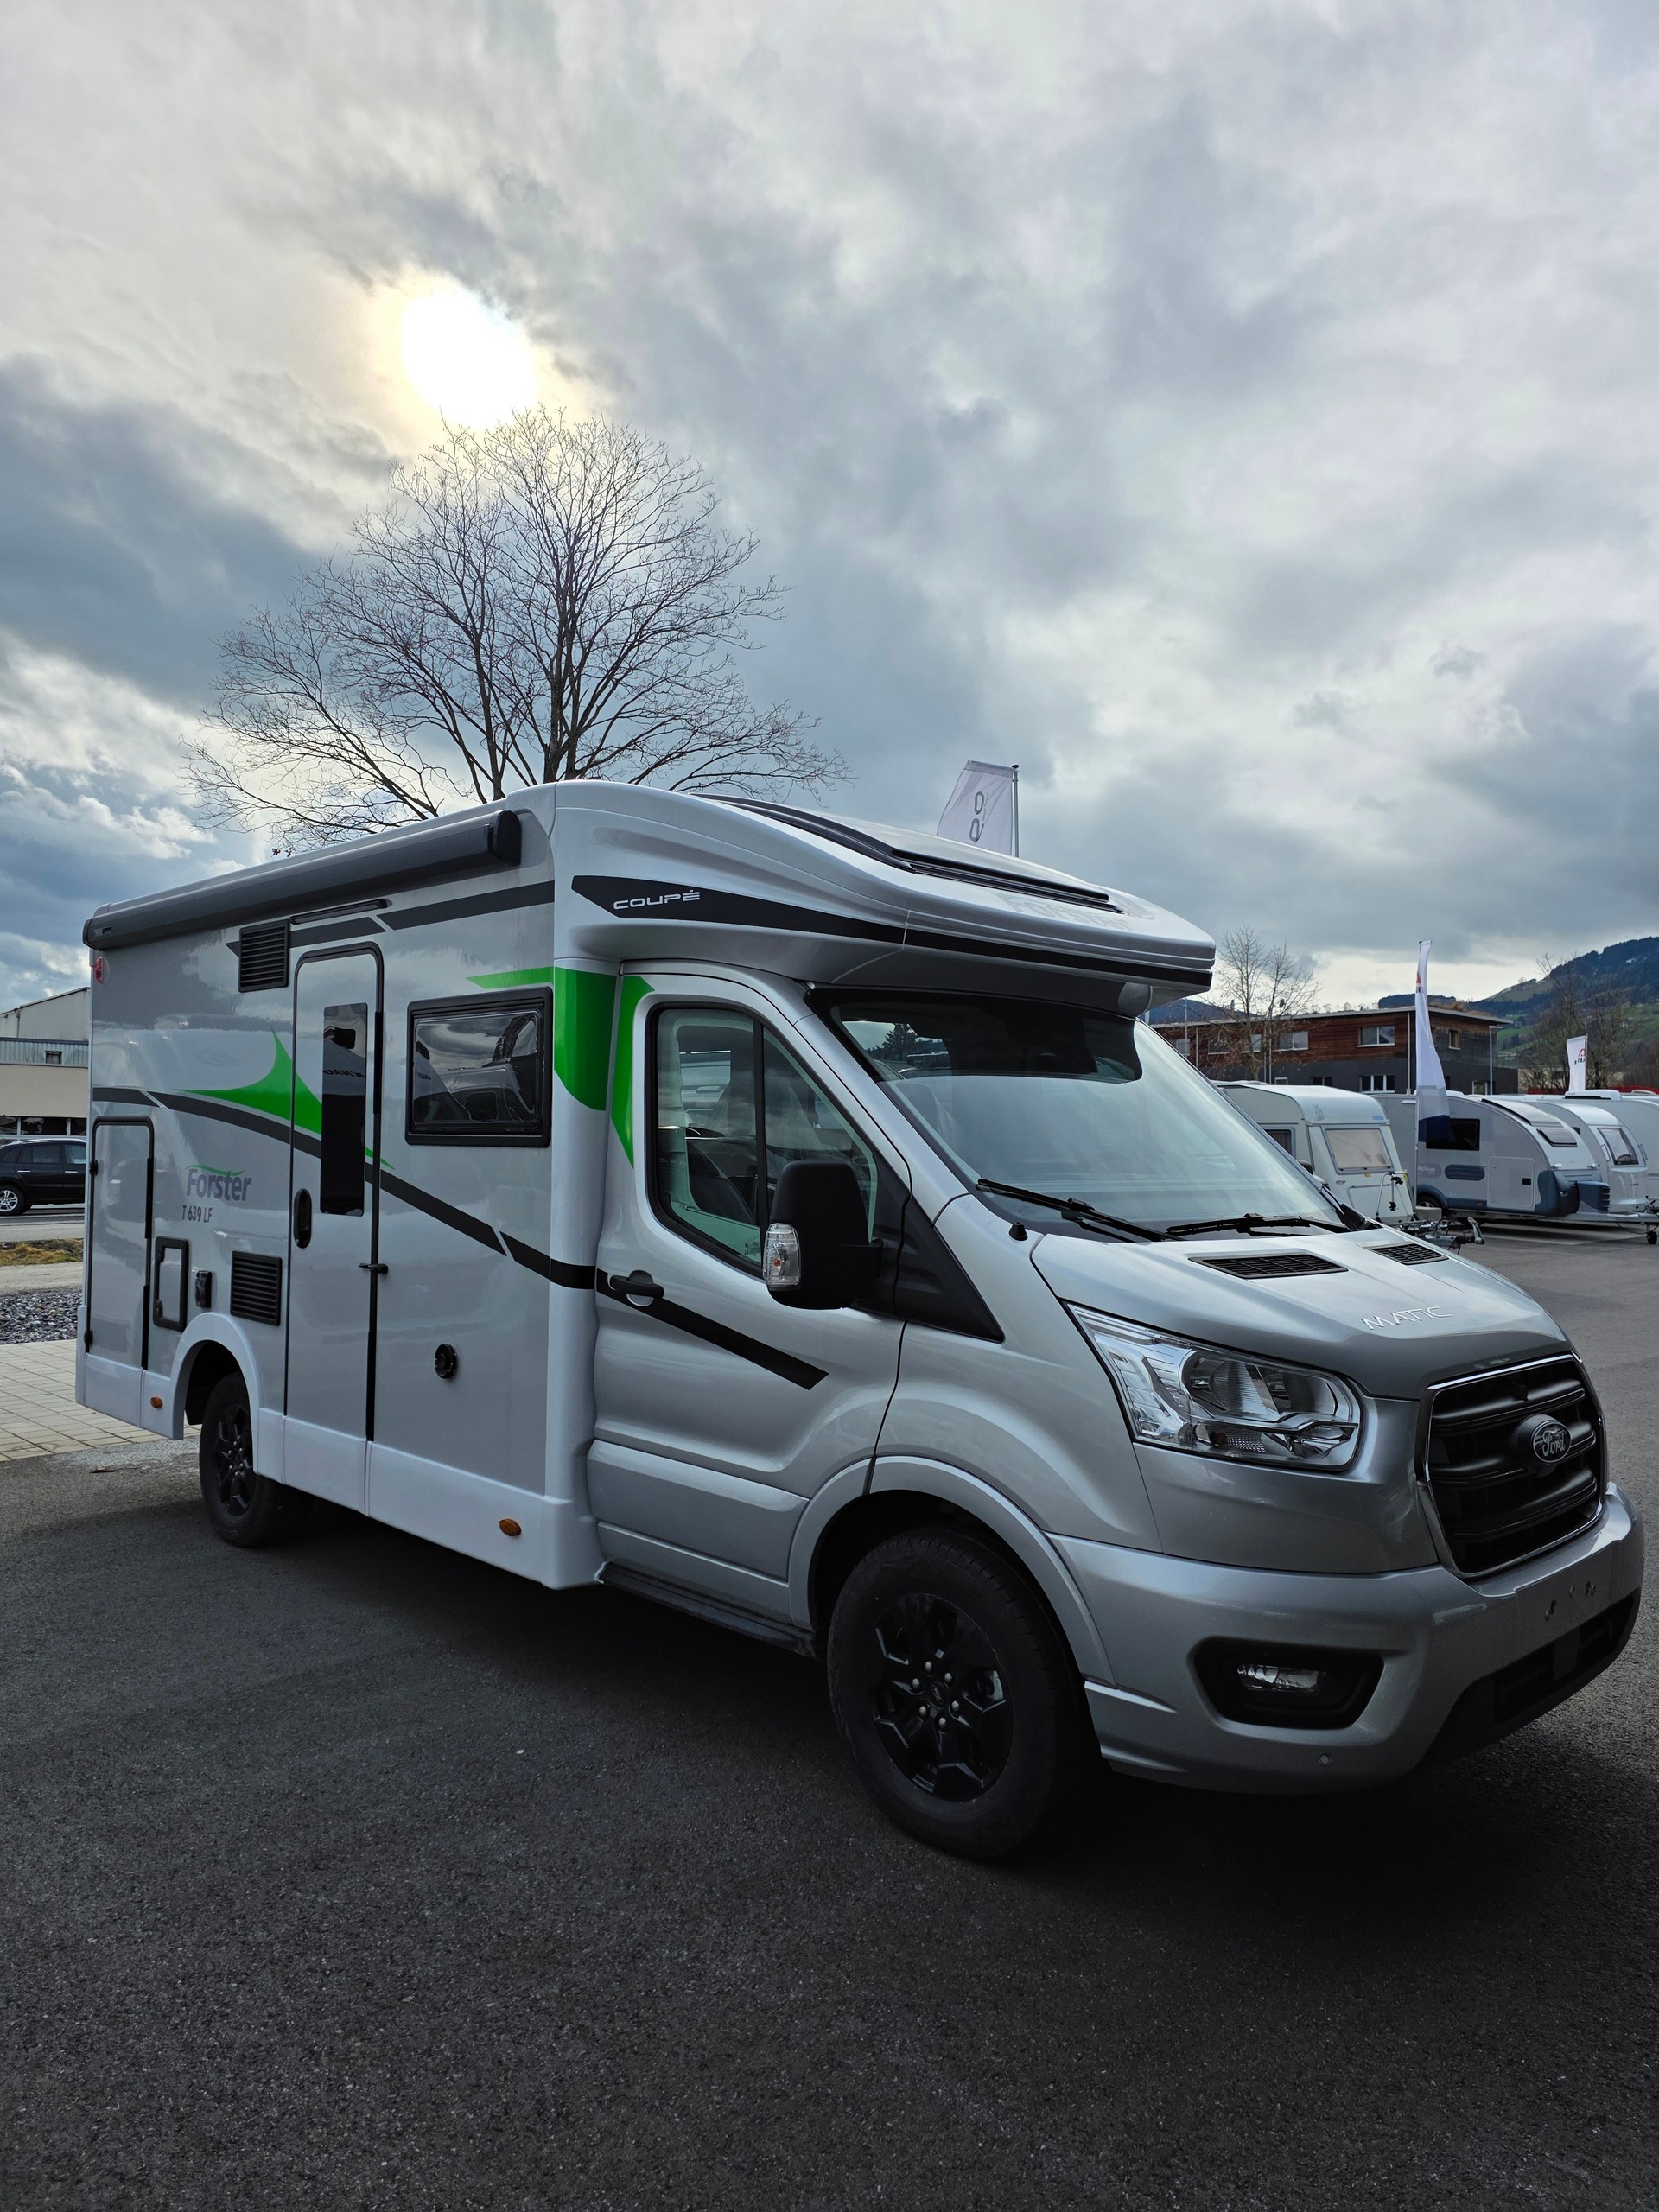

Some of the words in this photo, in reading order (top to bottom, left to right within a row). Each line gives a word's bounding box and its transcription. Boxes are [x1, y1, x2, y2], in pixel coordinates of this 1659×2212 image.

[613, 889, 701, 910] COUPÉ
[186, 1168, 252, 1202] Forster
[182, 1205, 188, 1221] T
[188, 1205, 202, 1222] 639
[203, 1207, 213, 1224] LF
[1541, 1428, 1566, 1457] Ford
